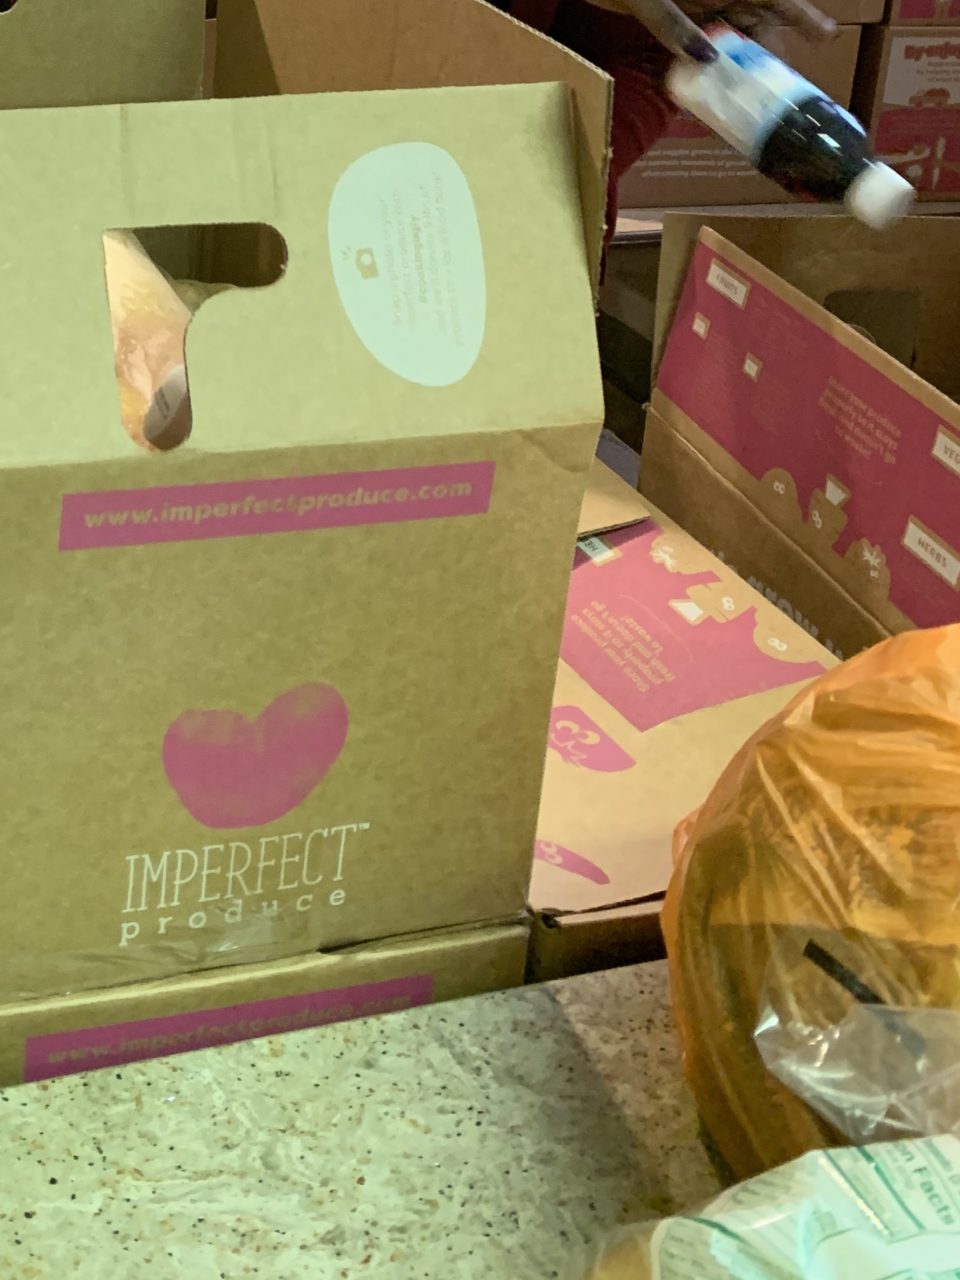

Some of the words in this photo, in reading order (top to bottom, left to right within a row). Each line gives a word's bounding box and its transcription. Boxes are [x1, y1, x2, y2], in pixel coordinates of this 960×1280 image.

[84, 481, 473, 529] www.imperfectproduce.com
[917, 537, 948, 568] HERBS
[119, 889, 346, 947] produce
[912, 1165, 955, 1225] Facts
